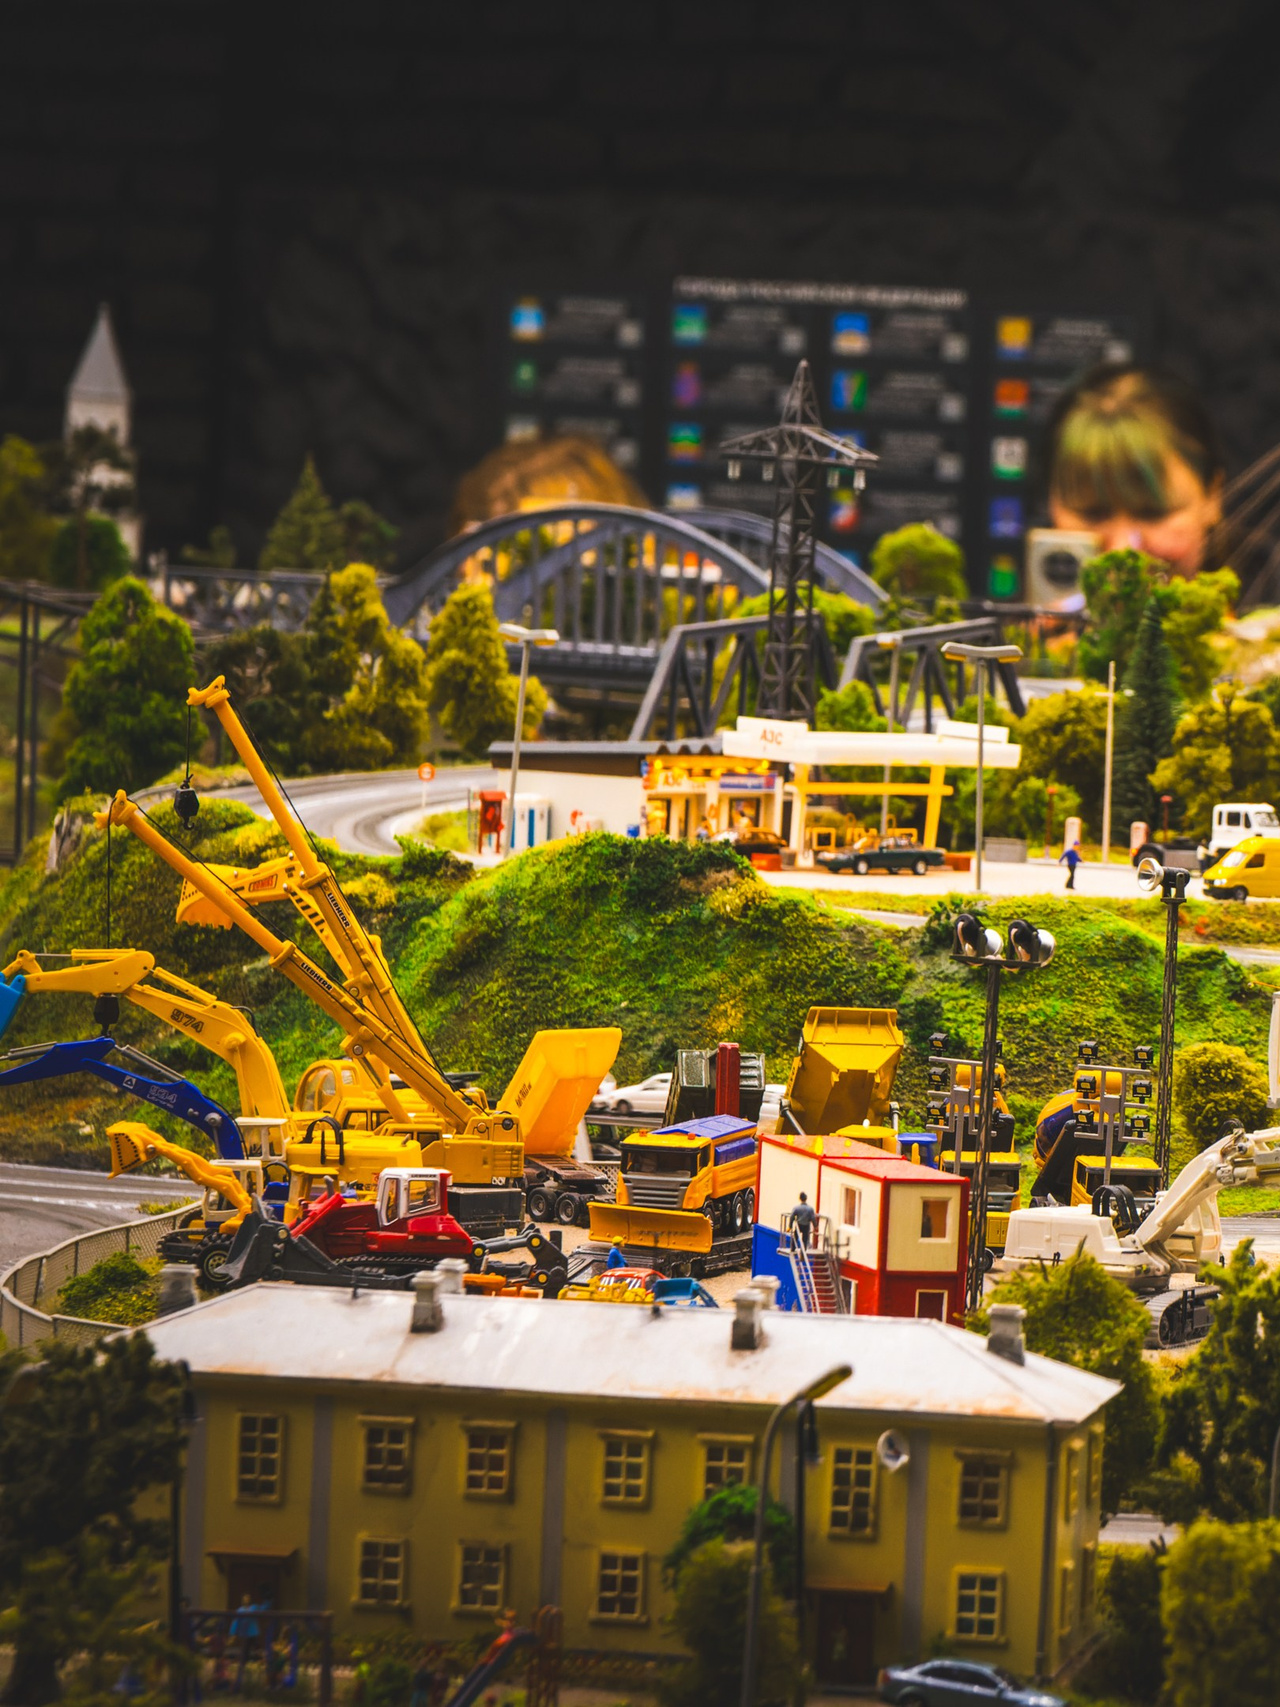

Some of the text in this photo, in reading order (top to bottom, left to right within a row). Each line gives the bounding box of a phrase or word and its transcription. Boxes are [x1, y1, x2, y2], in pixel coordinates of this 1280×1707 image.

[327, 892, 351, 928] LIEBHERR
[300, 962, 334, 992] LIEBHERR
[170, 1008, 205, 1034] 974
